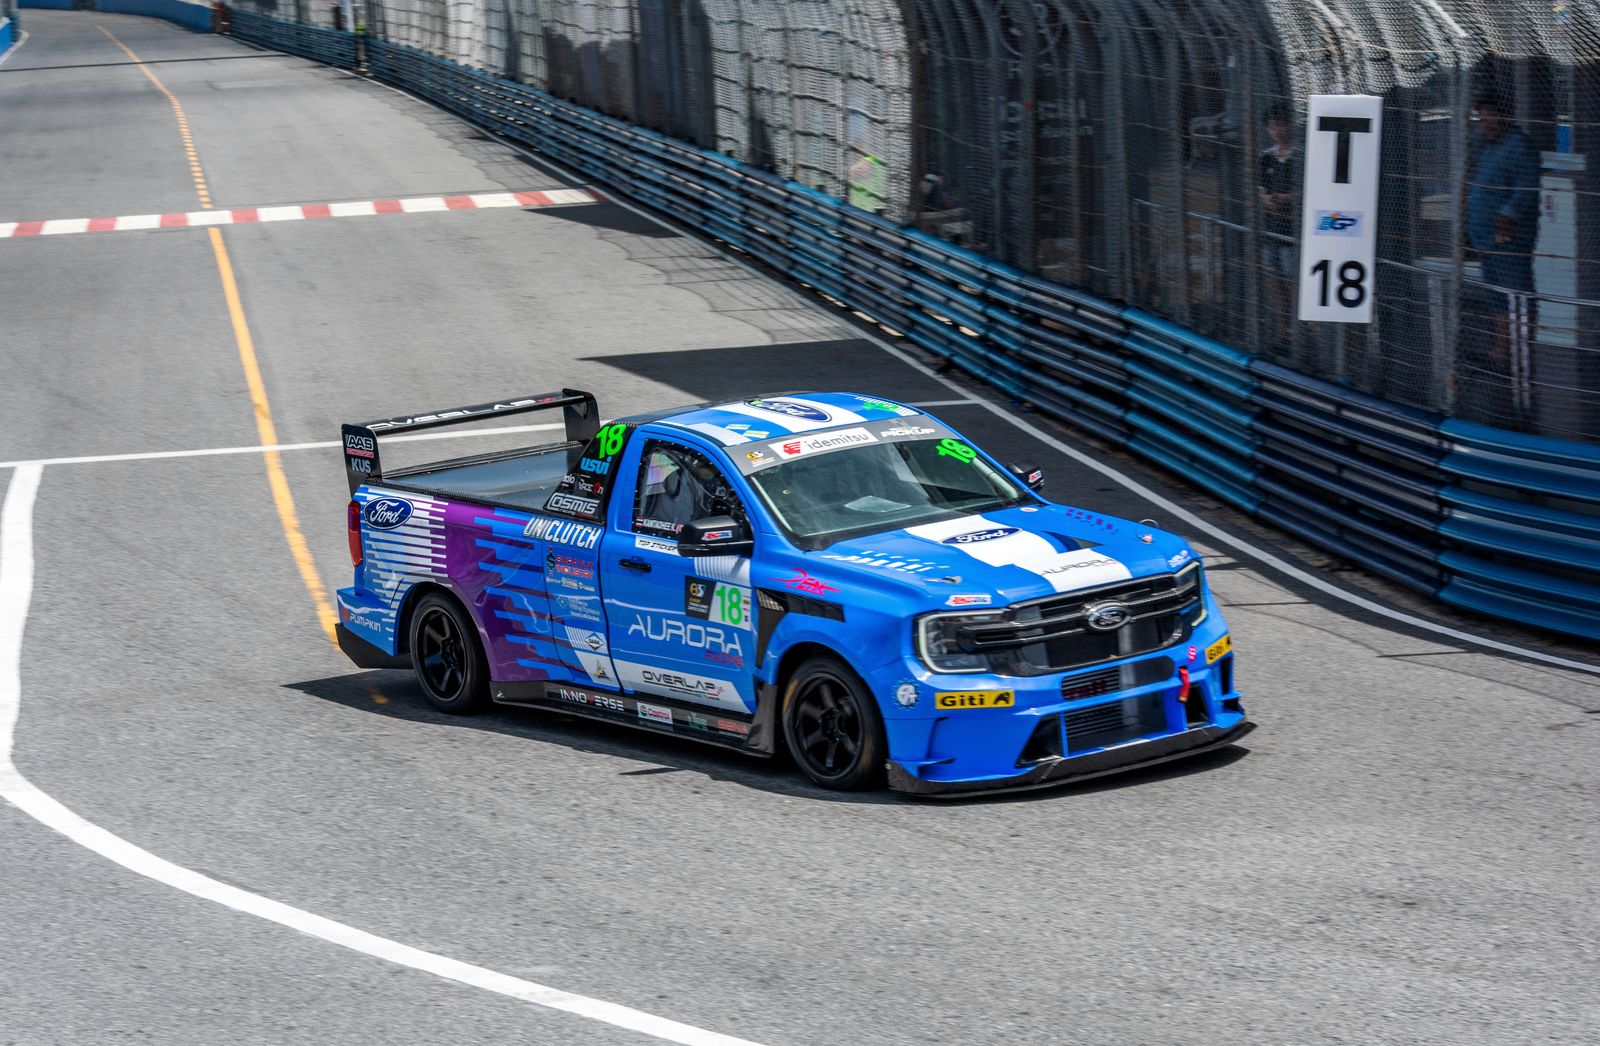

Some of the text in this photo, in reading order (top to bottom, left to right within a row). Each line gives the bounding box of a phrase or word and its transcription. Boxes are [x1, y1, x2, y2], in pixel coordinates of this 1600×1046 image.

[1316, 115, 1373, 184] T
[1310, 259, 1366, 308] 18
[595, 424, 627, 459] 18
[803, 433, 870, 450] idemitsu
[935, 438, 977, 464] 18
[351, 458, 372, 473] KUS
[370, 500, 405, 523] Ford
[547, 492, 601, 514] COSMIS
[523, 517, 602, 549] UNICLUTCH
[956, 529, 1009, 543] Ford
[715, 585, 743, 625] 18
[628, 614, 743, 657] AURORA
[642, 671, 715, 691] OVERLAP
[560, 688, 624, 712] INNOVERSE
[941, 695, 985, 706] Giti
